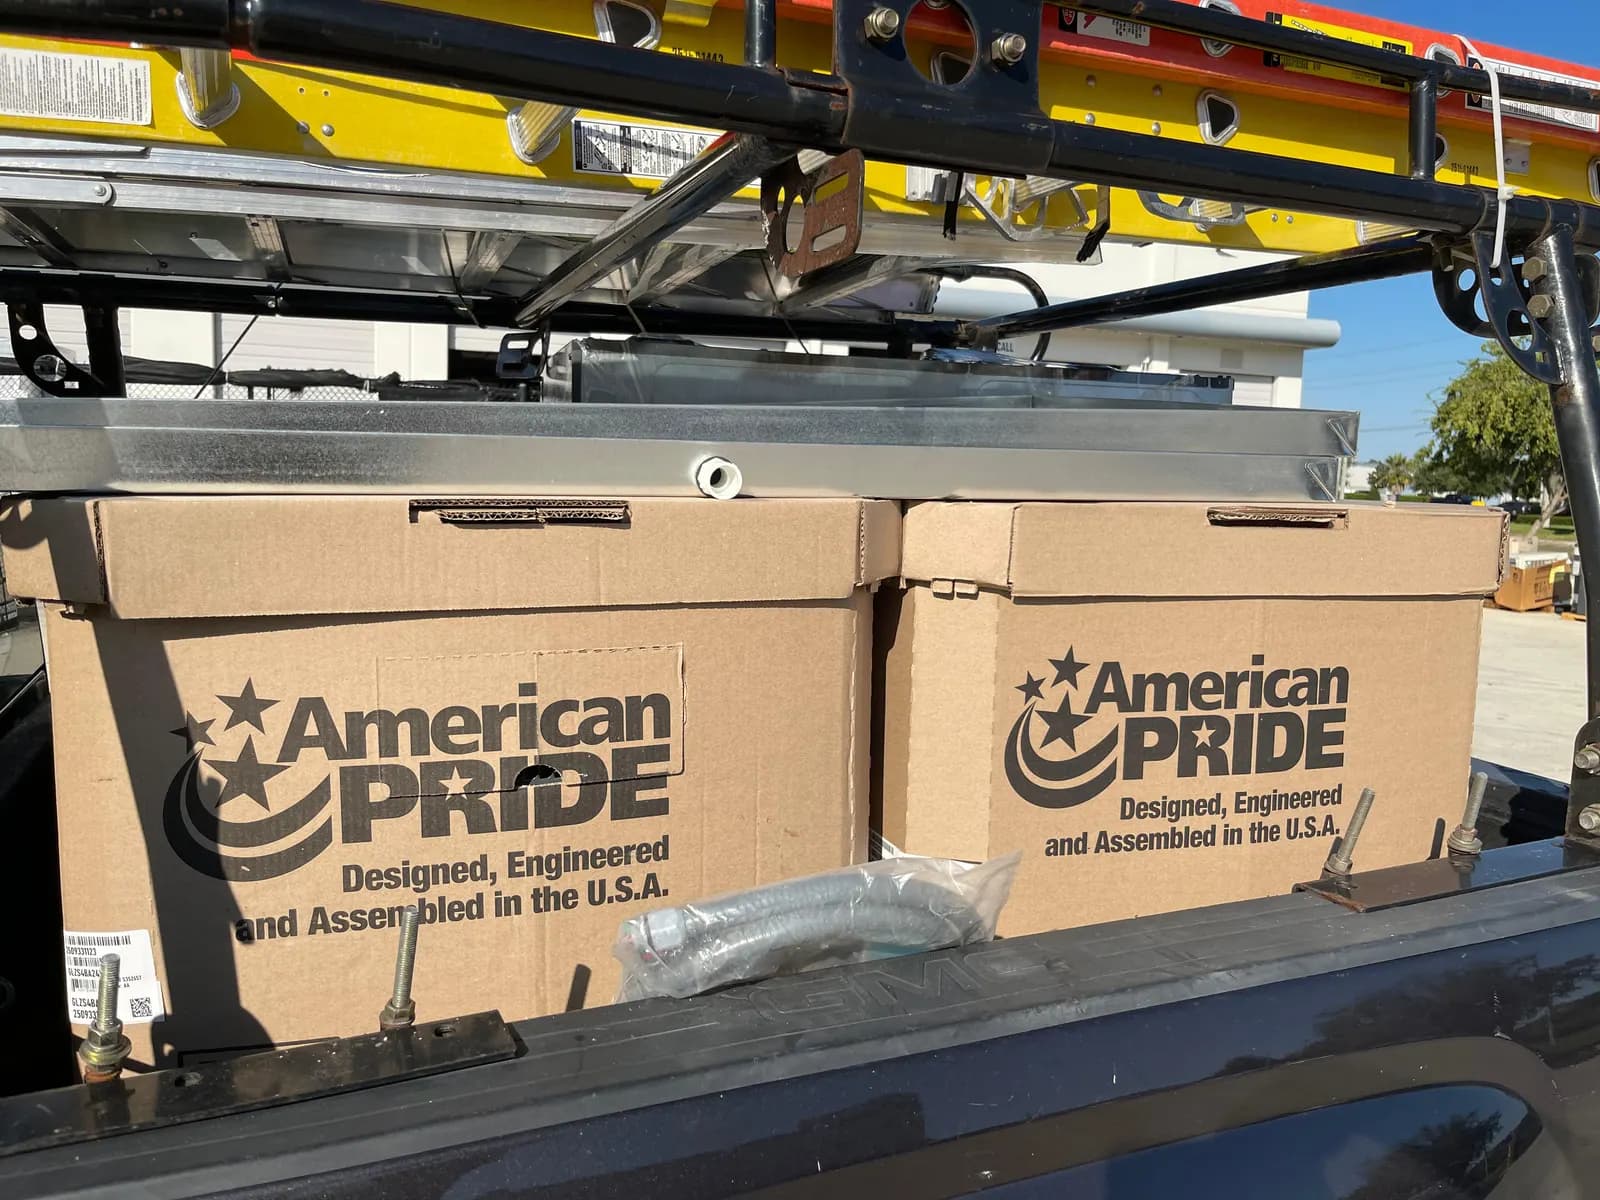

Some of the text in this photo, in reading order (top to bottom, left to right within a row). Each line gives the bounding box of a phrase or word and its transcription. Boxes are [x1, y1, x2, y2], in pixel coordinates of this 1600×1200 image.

[1083, 654, 1350, 714] American
[277, 682, 671, 763] American
[1122, 708, 1347, 780] PRIDE
[339, 743, 671, 844] PRIDE
[1120, 784, 1343, 823] Designed, Engineered
[342, 835, 670, 894] Designed, Engineered
[1045, 814, 1340, 857] and Assembled in the U.S.A.
[235, 908, 298, 944] and
[495, 889, 522, 918] in
[531, 885, 579, 914] the
[587, 872, 670, 906] U.S.A.
[749, 950, 1055, 1019] GMC
